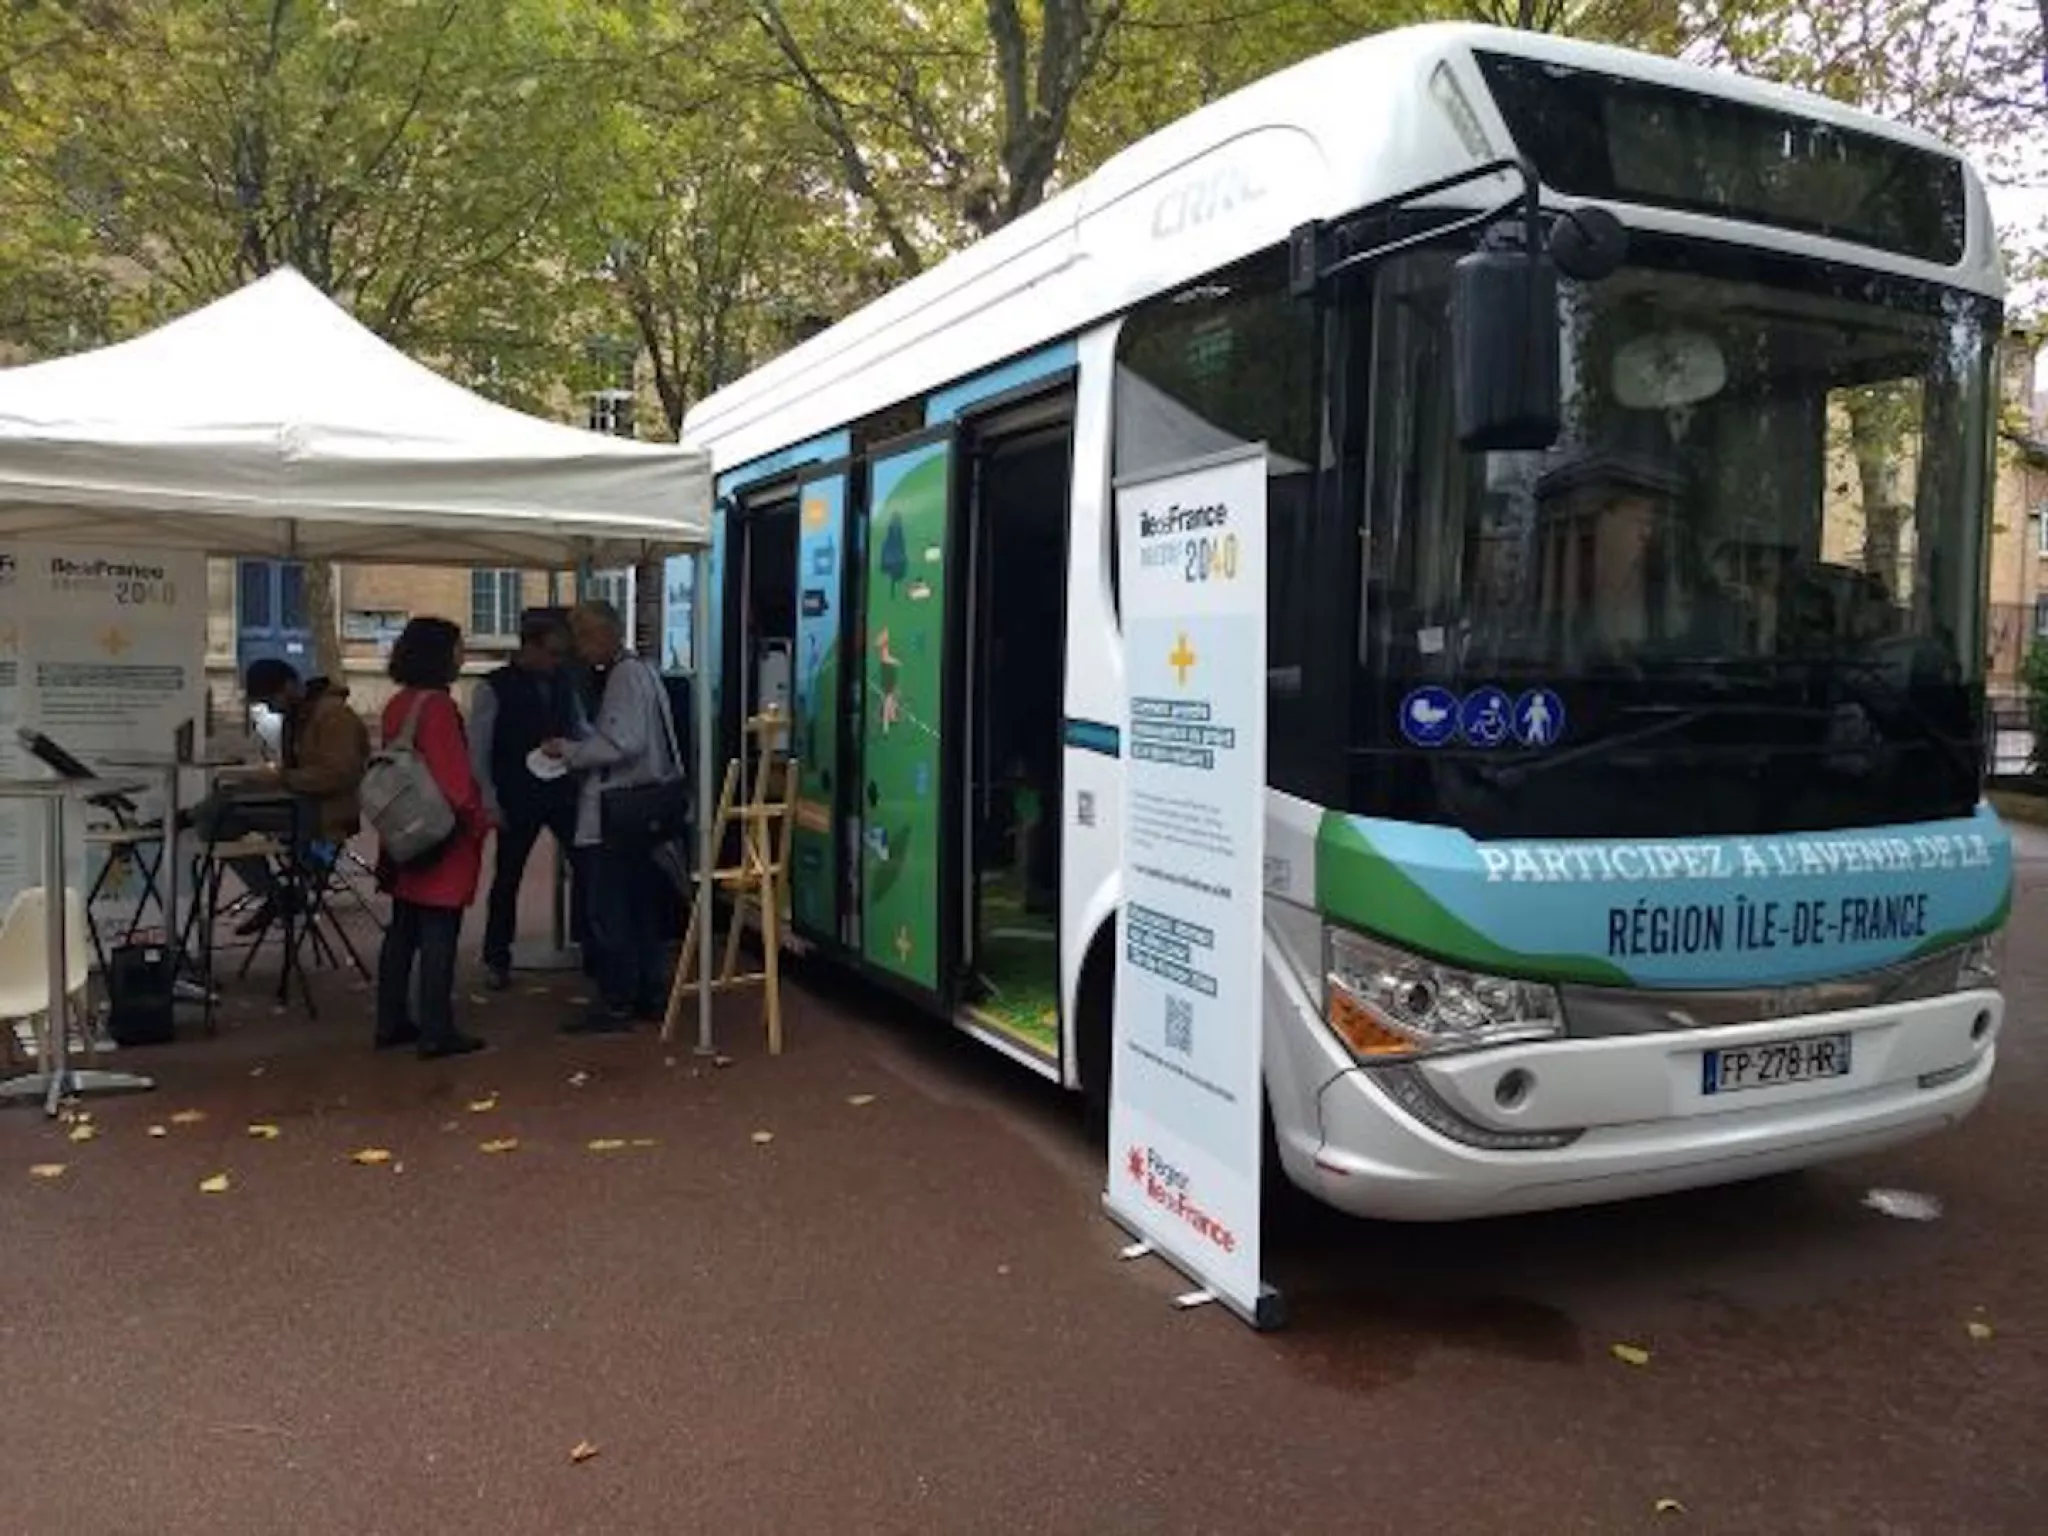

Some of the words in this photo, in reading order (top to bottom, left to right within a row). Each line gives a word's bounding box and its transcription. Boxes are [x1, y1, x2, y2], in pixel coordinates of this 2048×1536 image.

[1477, 843, 1732, 883] PARTICIPEZ
[1767, 837, 1914, 877] L'AVENIR
[1913, 835, 1955, 869] DE
[1609, 899, 1724, 957] RÉGION
[1736, 893, 1929, 950] ÎLE-DE-FRANCE
[1720, 1040, 1836, 1085] FP-278-HR
